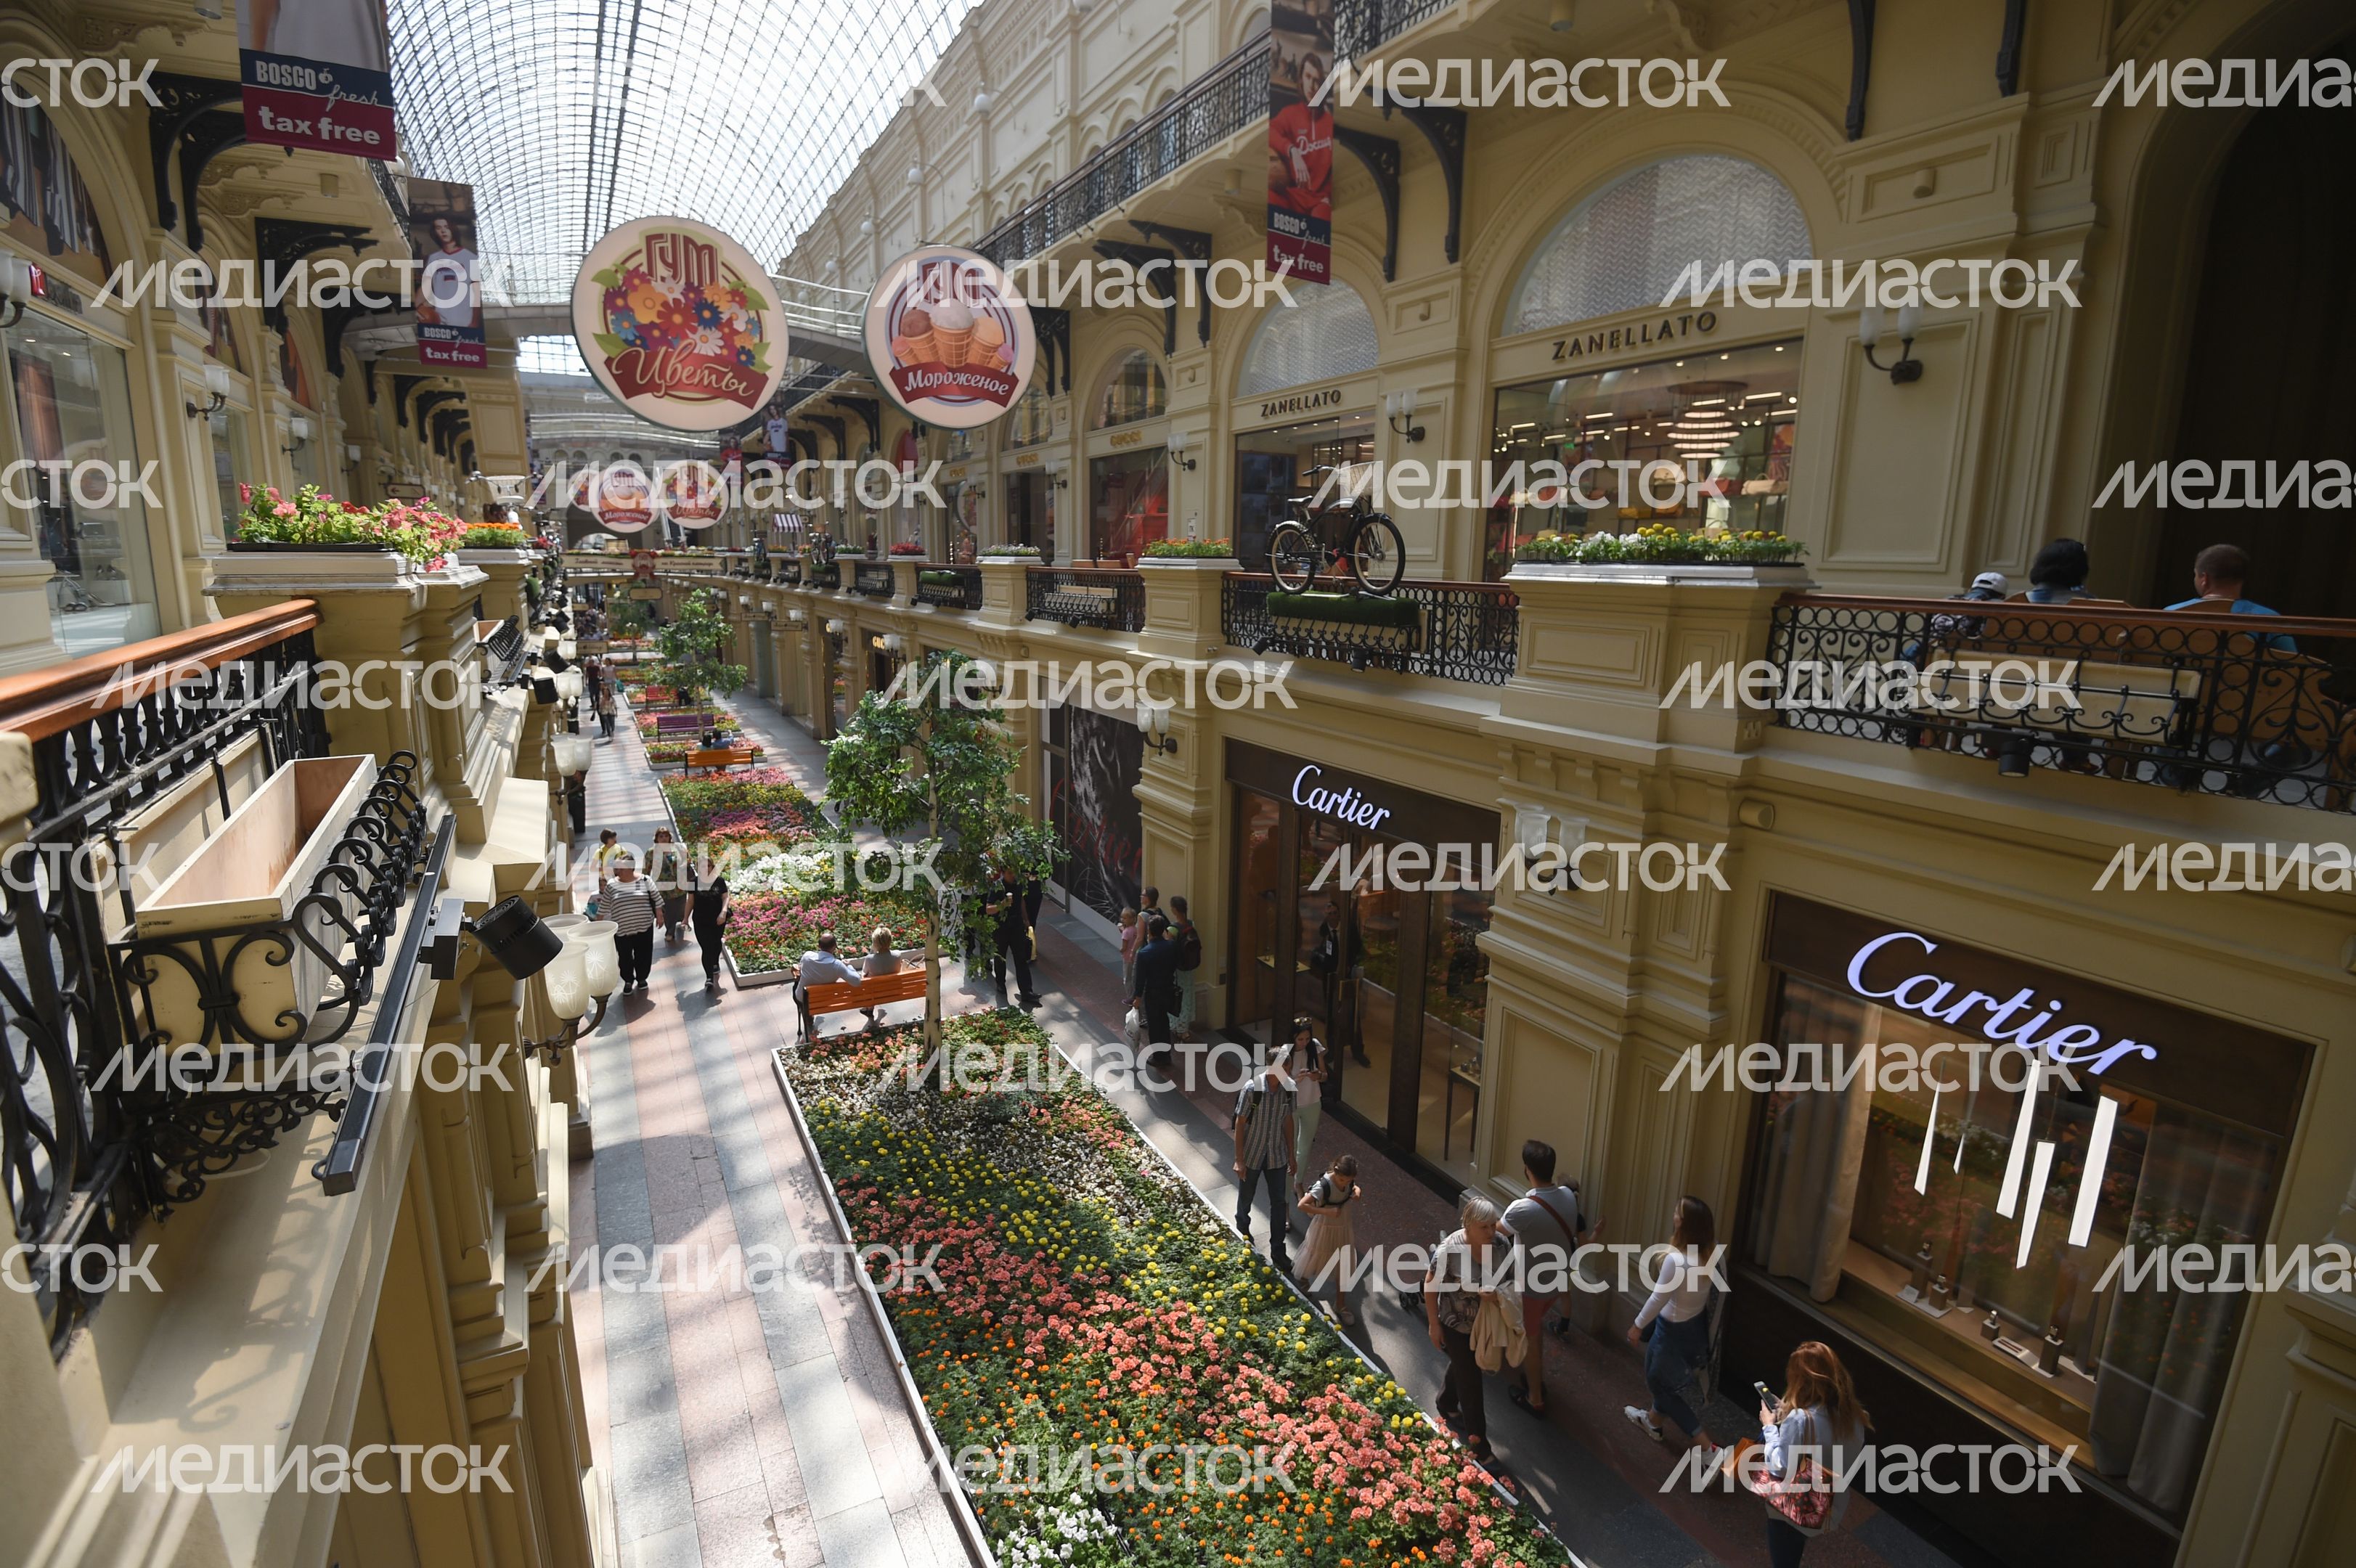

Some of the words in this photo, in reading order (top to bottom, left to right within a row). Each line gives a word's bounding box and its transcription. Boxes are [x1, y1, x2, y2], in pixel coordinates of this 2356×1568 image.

[256, 60, 317, 90] BOSCO
[326, 85, 378, 111] fresh
[258, 106, 313, 135] tax
[318, 118, 380, 144] free
[1273, 213, 1300, 234] BOSCO
[645, 233, 719, 286] ГУМ
[1273, 245, 1295, 266] tax
[1297, 254, 1324, 273] free
[424, 327, 452, 339] BOSCO
[1552, 311, 1716, 359] ZANELLATO
[426, 347, 449, 359] tax
[452, 352, 480, 362] free
[612, 339, 754, 396] Цветы
[905, 369, 1009, 396] Мороженое
[1261, 390, 1341, 417] ZANELLATO
[873, 635, 885, 650] GUC
[1293, 764, 1390, 830] Cartier
[1847, 932, 2157, 1075] Cartier
